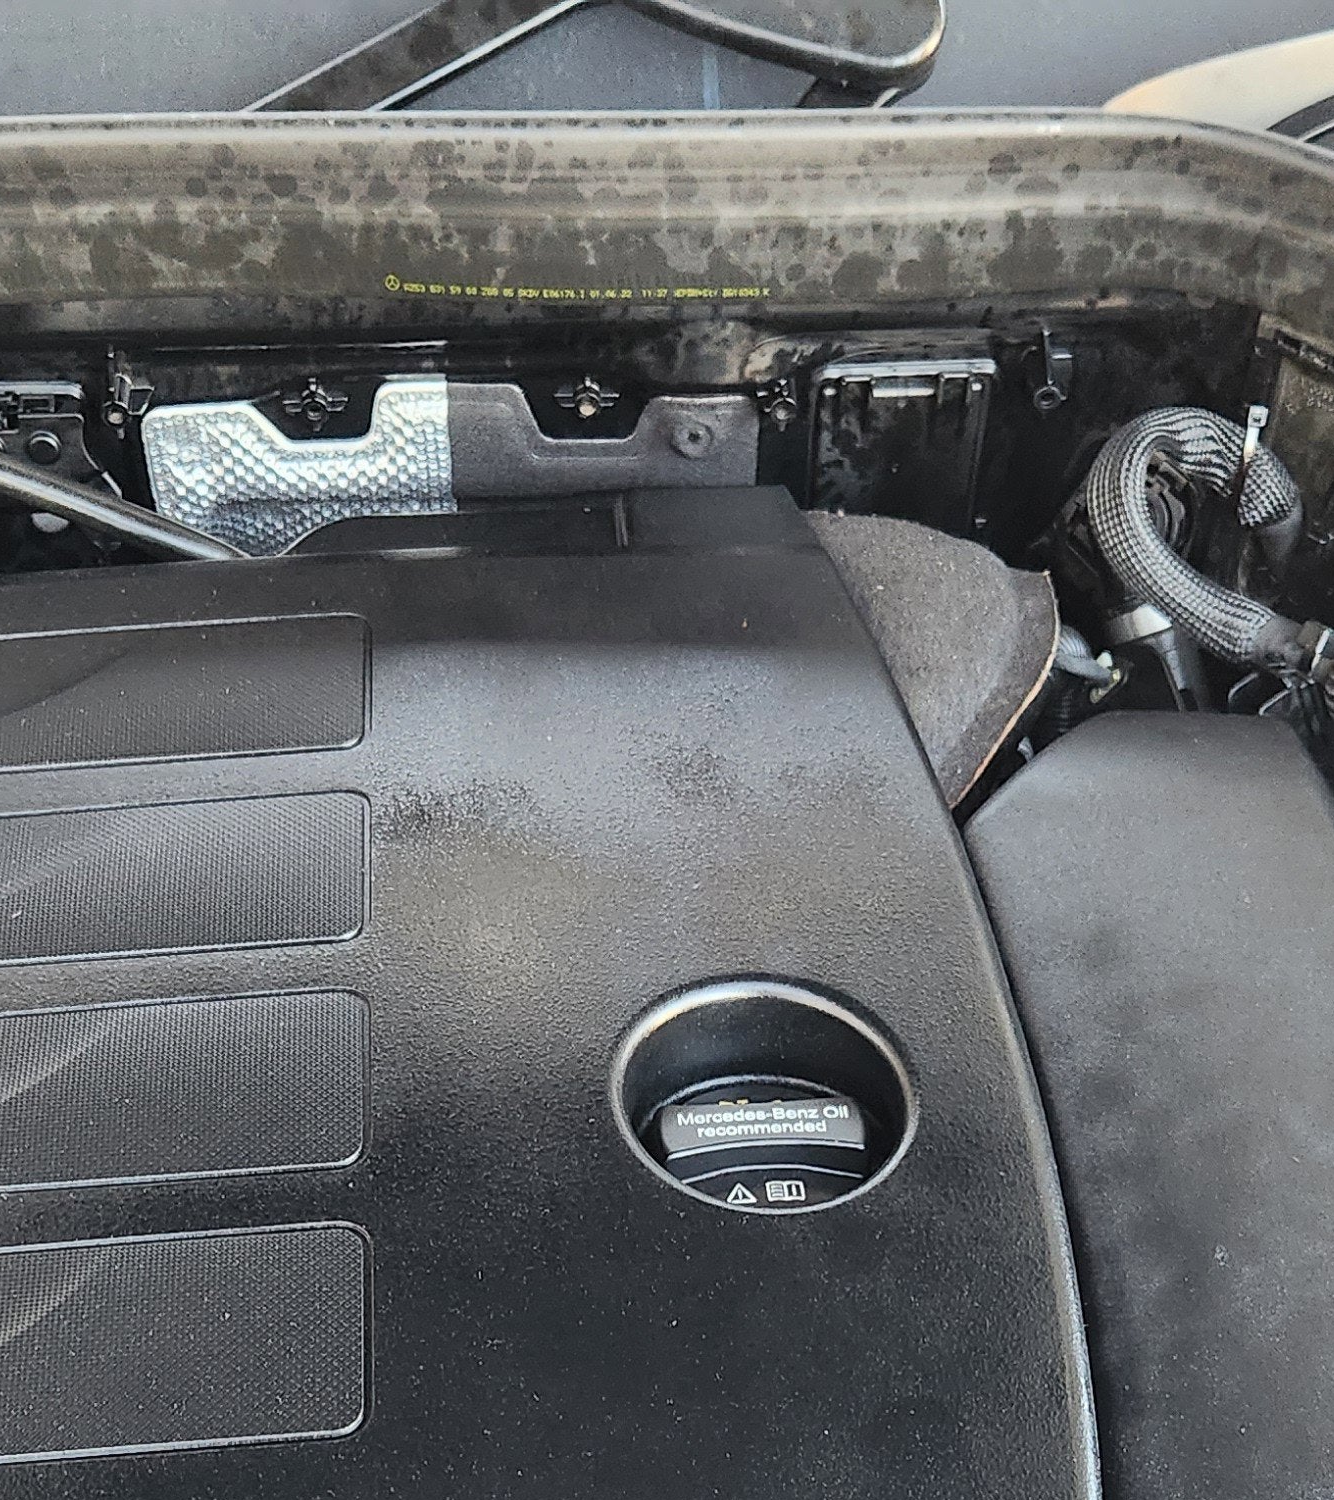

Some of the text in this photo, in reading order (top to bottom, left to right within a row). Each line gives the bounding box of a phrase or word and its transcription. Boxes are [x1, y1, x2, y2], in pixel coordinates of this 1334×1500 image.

[677, 1104, 849, 1126] Mercedes-Benz Oil
[697, 1119, 827, 1138] recommended
